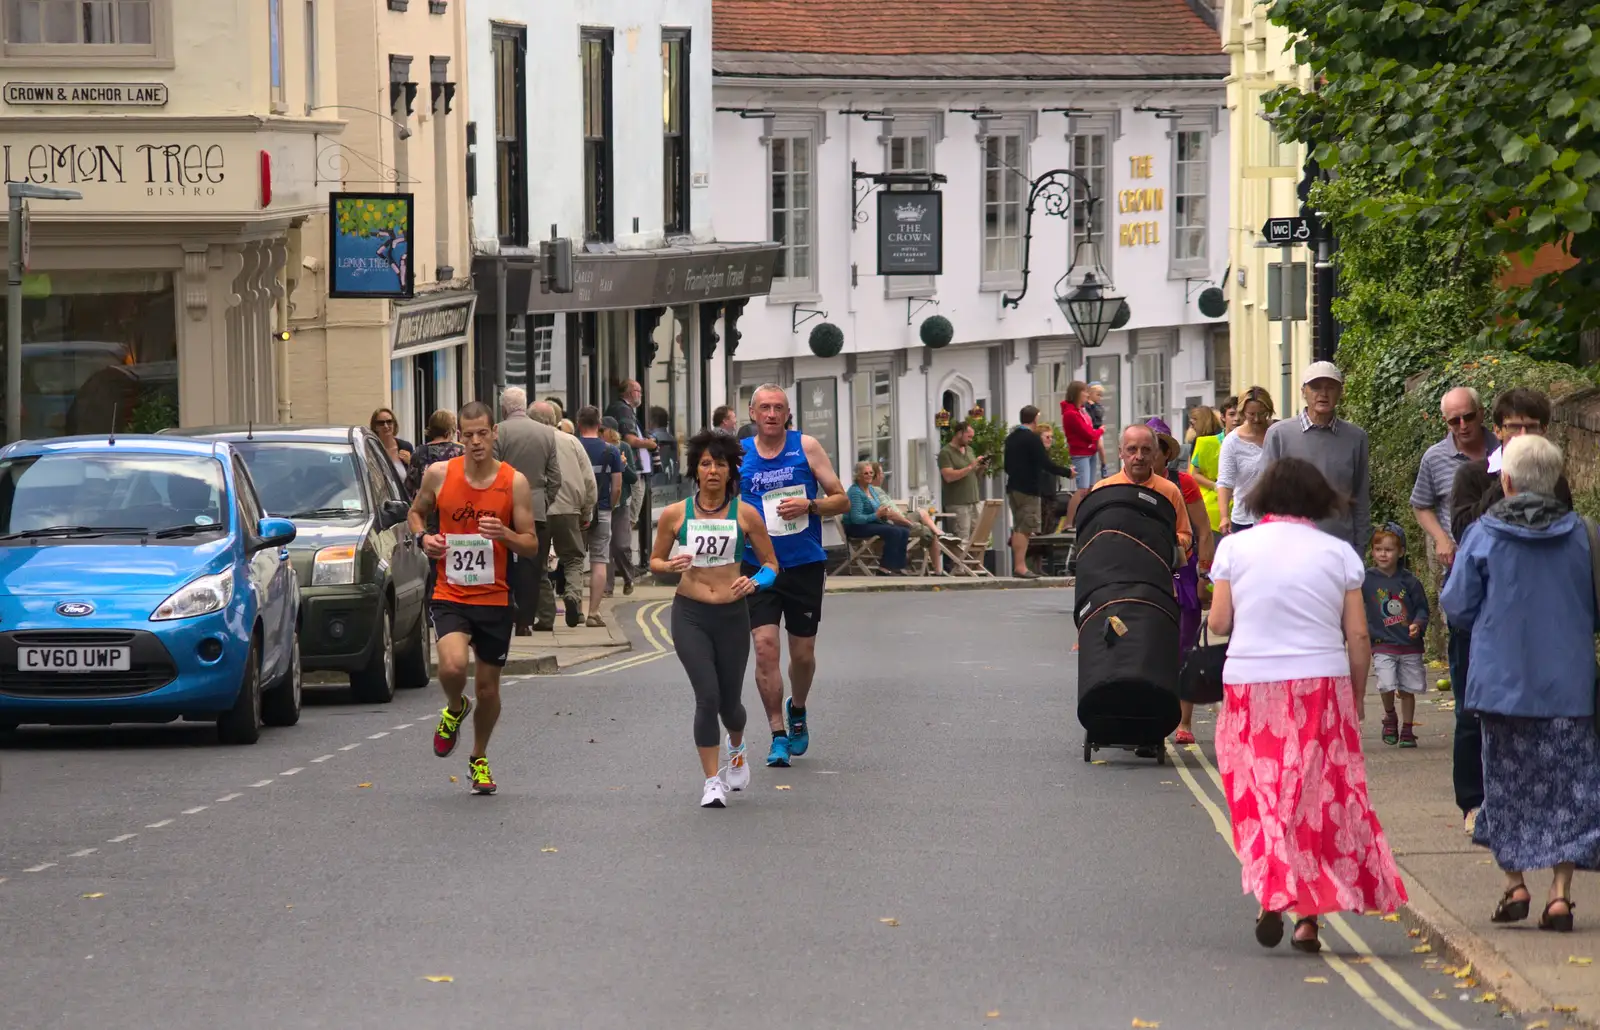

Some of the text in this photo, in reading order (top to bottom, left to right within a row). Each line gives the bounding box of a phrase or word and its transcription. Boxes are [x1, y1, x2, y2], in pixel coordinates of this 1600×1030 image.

[10, 88, 161, 101] CROWN & ANCHOR LANE
[1129, 155, 1153, 179] THE
[146, 187, 215, 196] BISTRO
[1119, 187, 1164, 214] CROWN
[898, 224, 921, 233] THE
[1273, 225, 1288, 235] WC
[888, 233, 931, 242] CROWN
[1119, 221, 1160, 247] HOTEL
[684, 265, 725, 295] Framlingham
[726, 263, 747, 287] Travel
[763, 467, 795, 478] BENTLEY
[761, 474, 793, 484] RUNNING
[764, 482, 784, 490] CLUB
[784, 523, 797, 531] 10K
[695, 536, 730, 557] 287
[453, 550, 486, 571] 324
[464, 574, 478, 583] 10K
[64, 603, 86, 613] Ford
[27, 649, 121, 667] CV60 UWP
